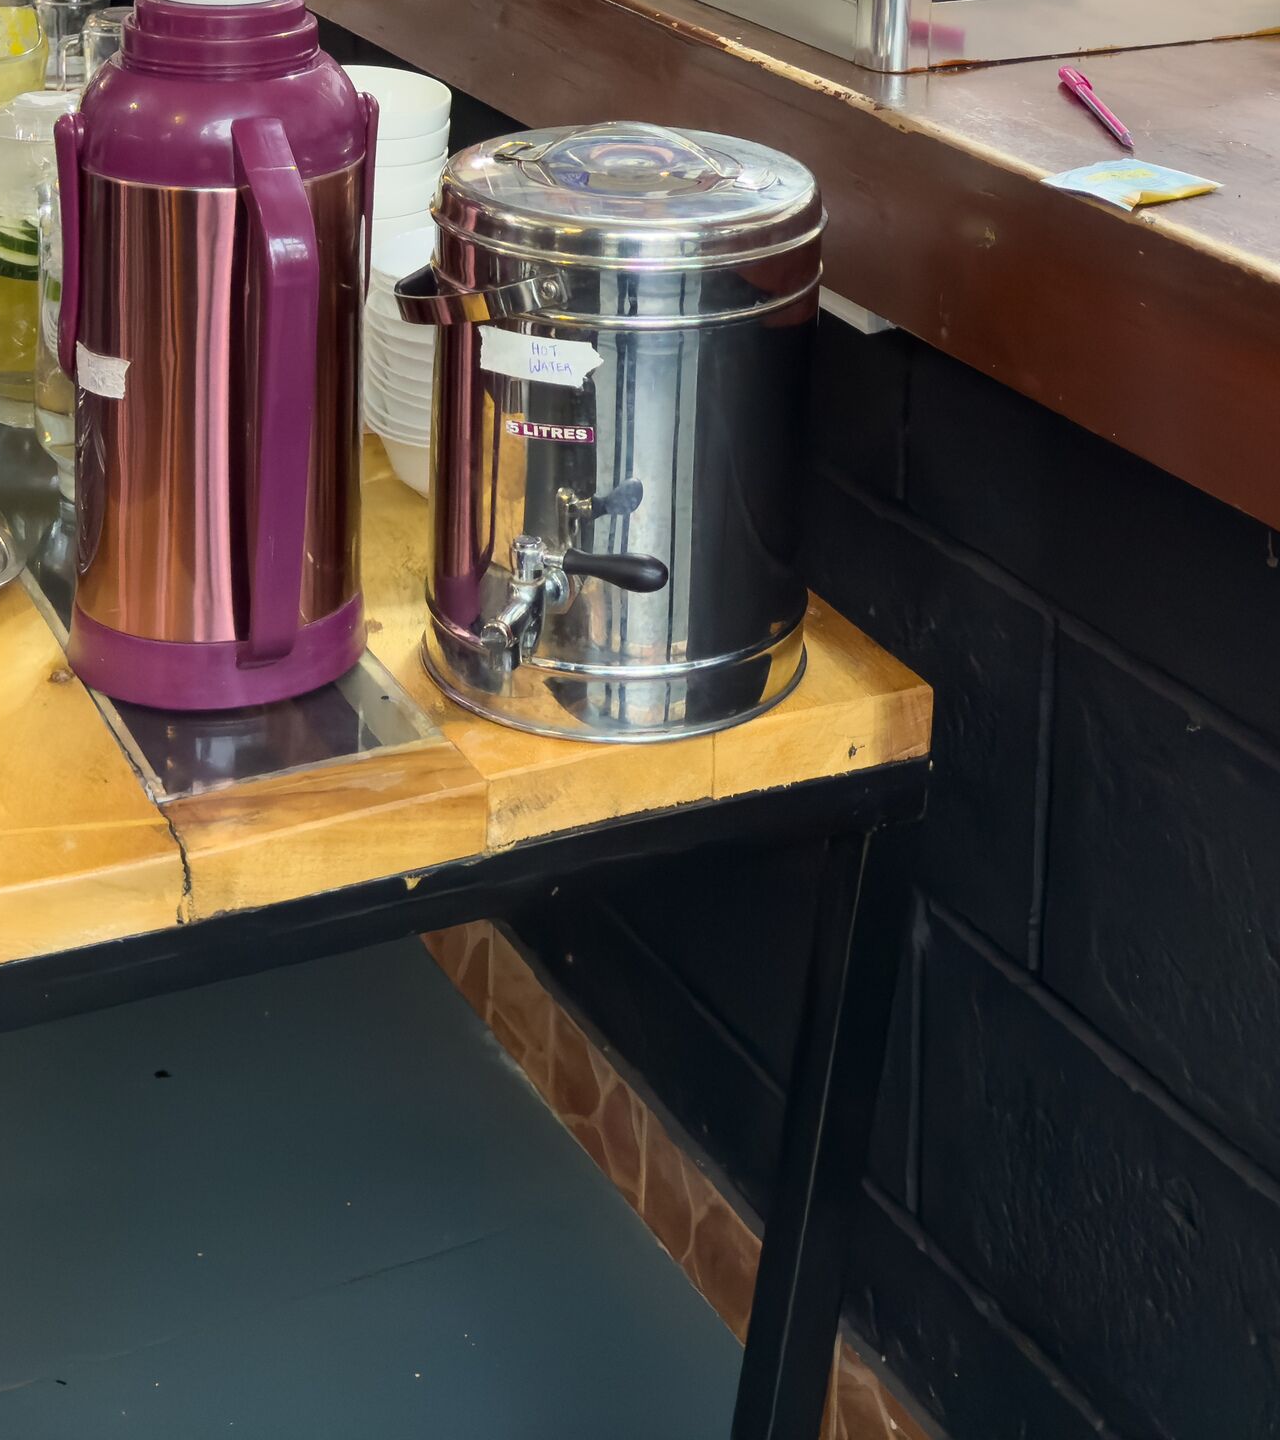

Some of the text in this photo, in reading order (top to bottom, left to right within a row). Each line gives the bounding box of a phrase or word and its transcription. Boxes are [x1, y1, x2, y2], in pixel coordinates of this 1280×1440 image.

[531, 341, 558, 357] HOT
[528, 360, 572, 376] WATER
[523, 424, 588, 440] LITRES
